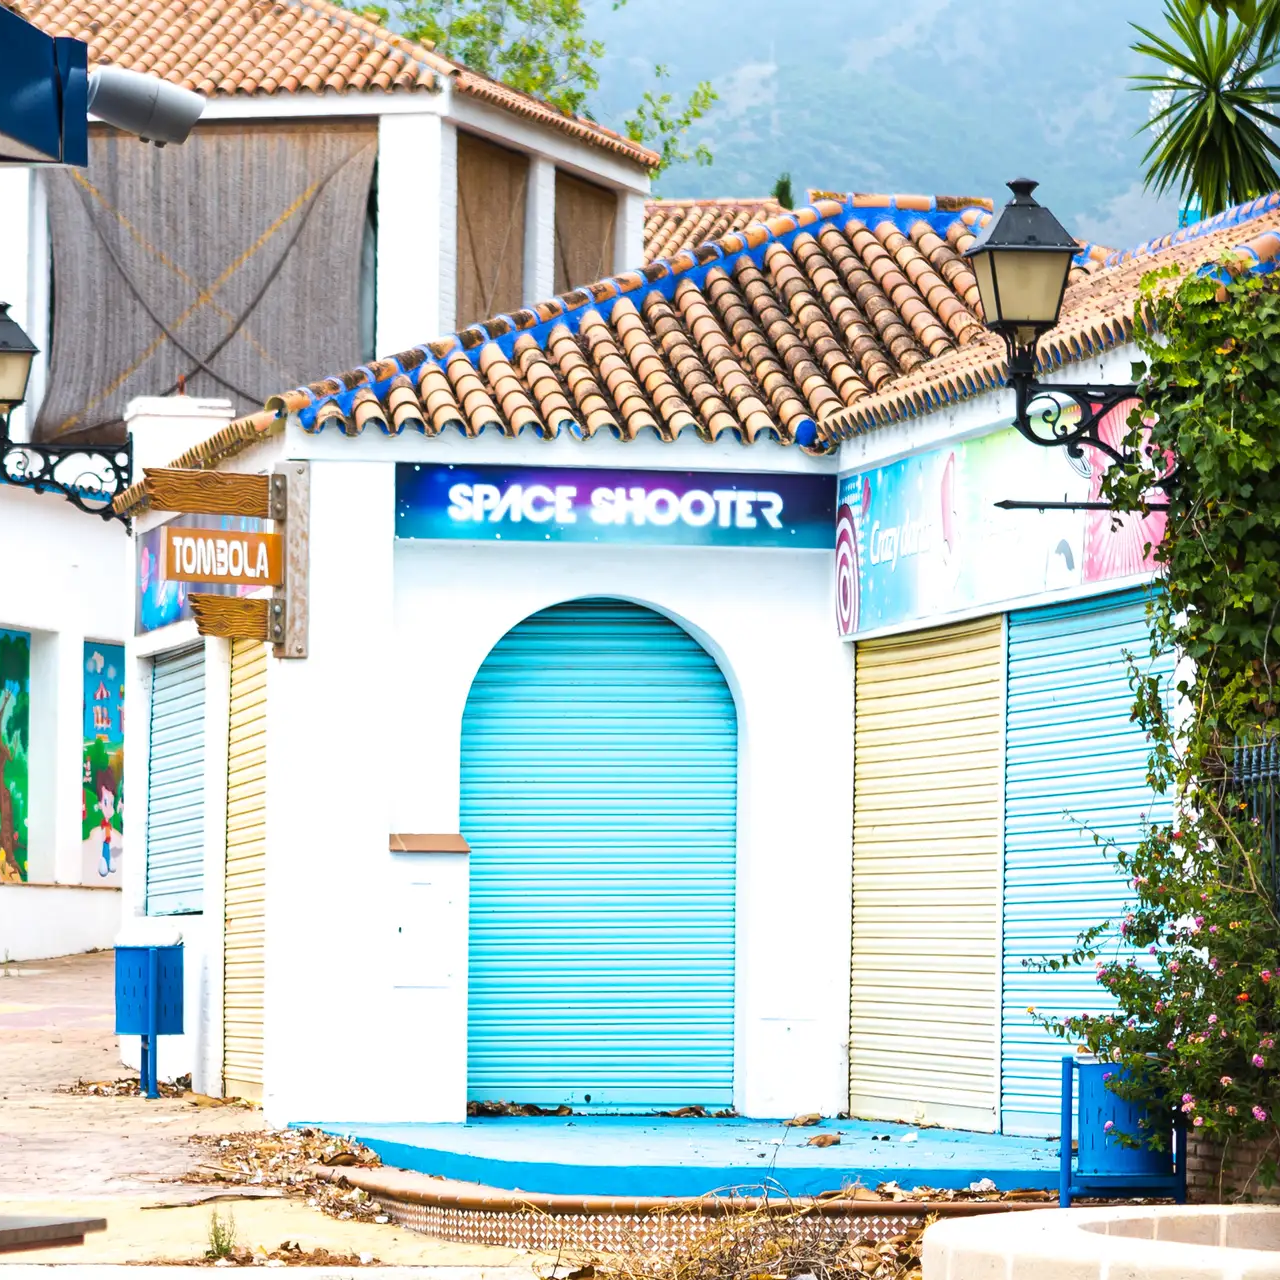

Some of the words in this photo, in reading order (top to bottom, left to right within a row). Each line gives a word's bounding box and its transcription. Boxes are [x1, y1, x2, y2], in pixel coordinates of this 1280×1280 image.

[447, 481, 576, 523] SPACE
[589, 486, 784, 529] SHOOTER
[171, 535, 270, 579] TOMBOLA
[870, 520, 901, 573] Crazy
